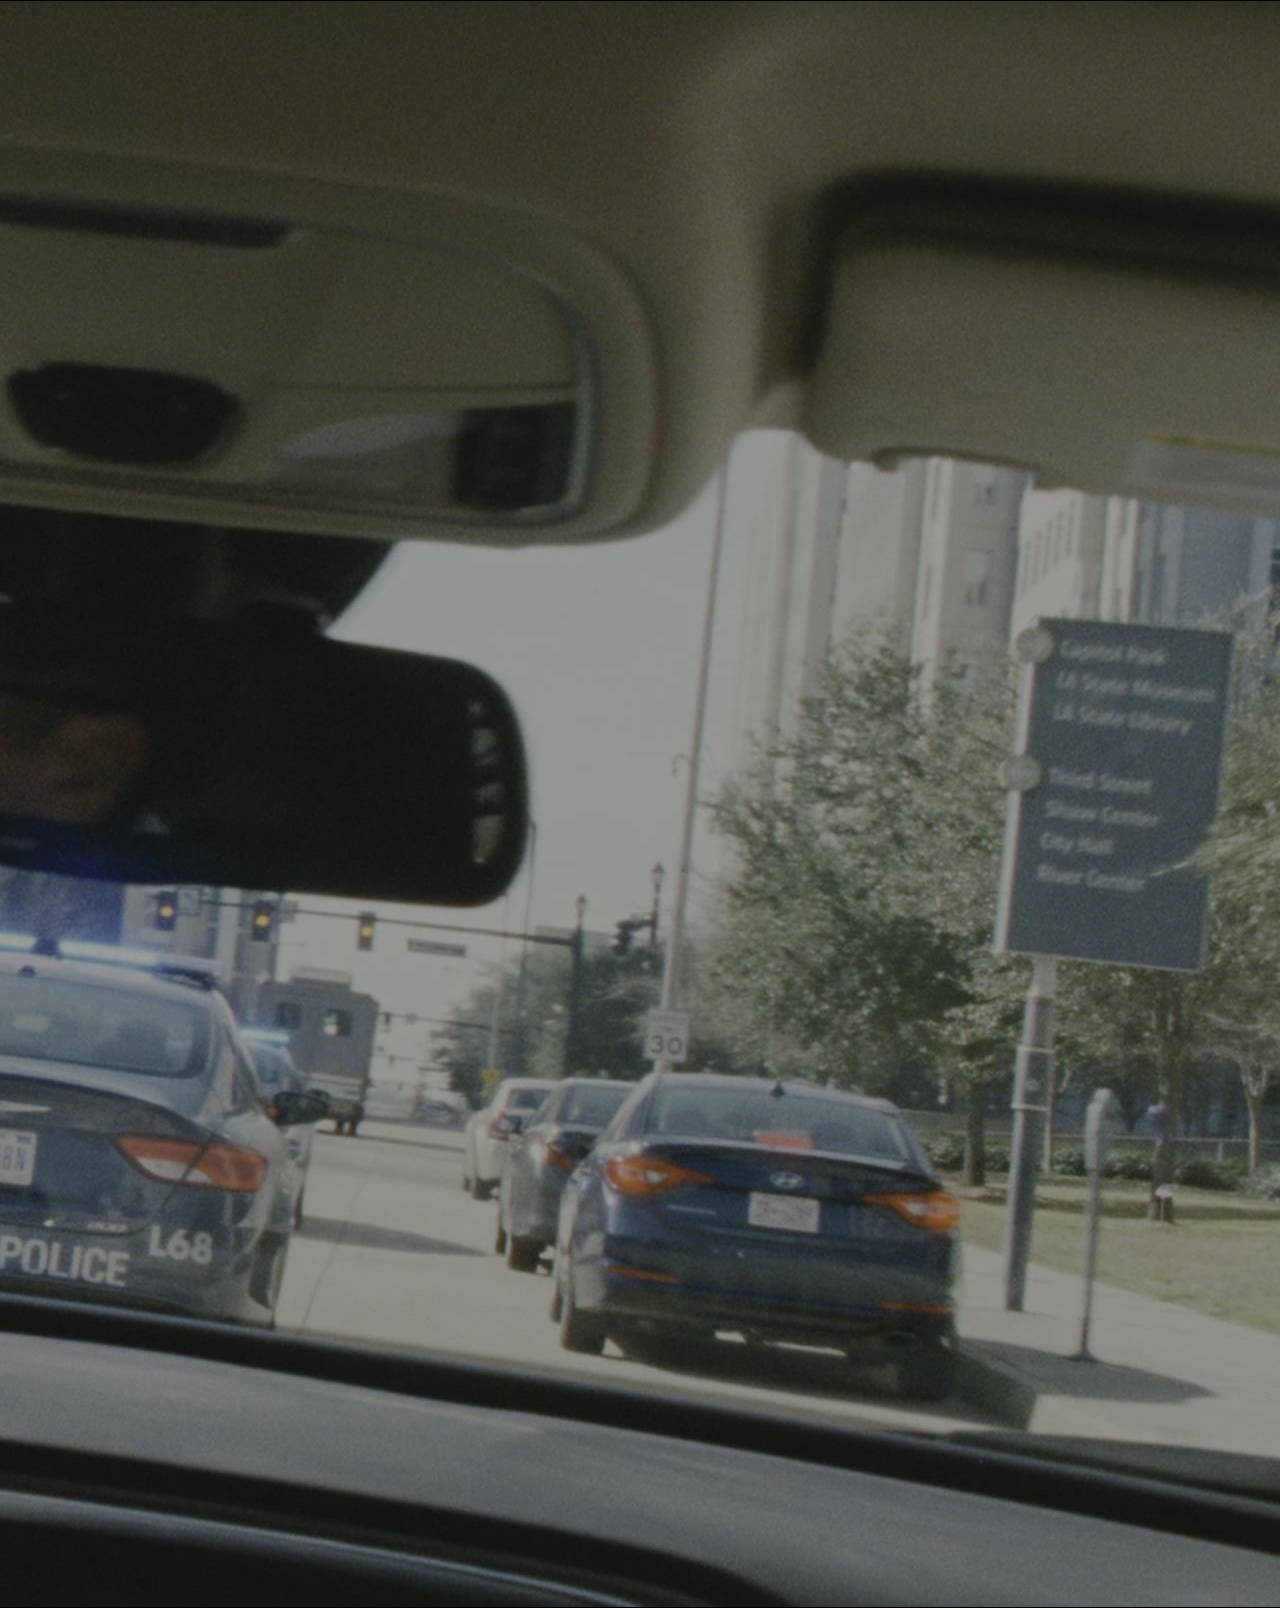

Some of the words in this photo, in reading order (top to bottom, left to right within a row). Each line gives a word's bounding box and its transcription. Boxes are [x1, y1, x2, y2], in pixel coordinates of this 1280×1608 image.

[1059, 640, 1123, 663] Capitol
[1125, 643, 1167, 667] Park
[1056, 670, 1078, 690] LA
[1081, 672, 1128, 694] State
[1131, 678, 1215, 702] Museum
[1078, 705, 1126, 727] State
[1127, 709, 1192, 737] Library
[1097, 772, 1153, 795] Street
[1100, 805, 1160, 828] Center
[1040, 831, 1074, 855] City
[1076, 836, 1113, 855] Hall
[1037, 863, 1083, 886] River
[1085, 868, 1147, 892] Center
[649, 1034, 683, 1056] 30
[148, 1225, 213, 1265] L68
